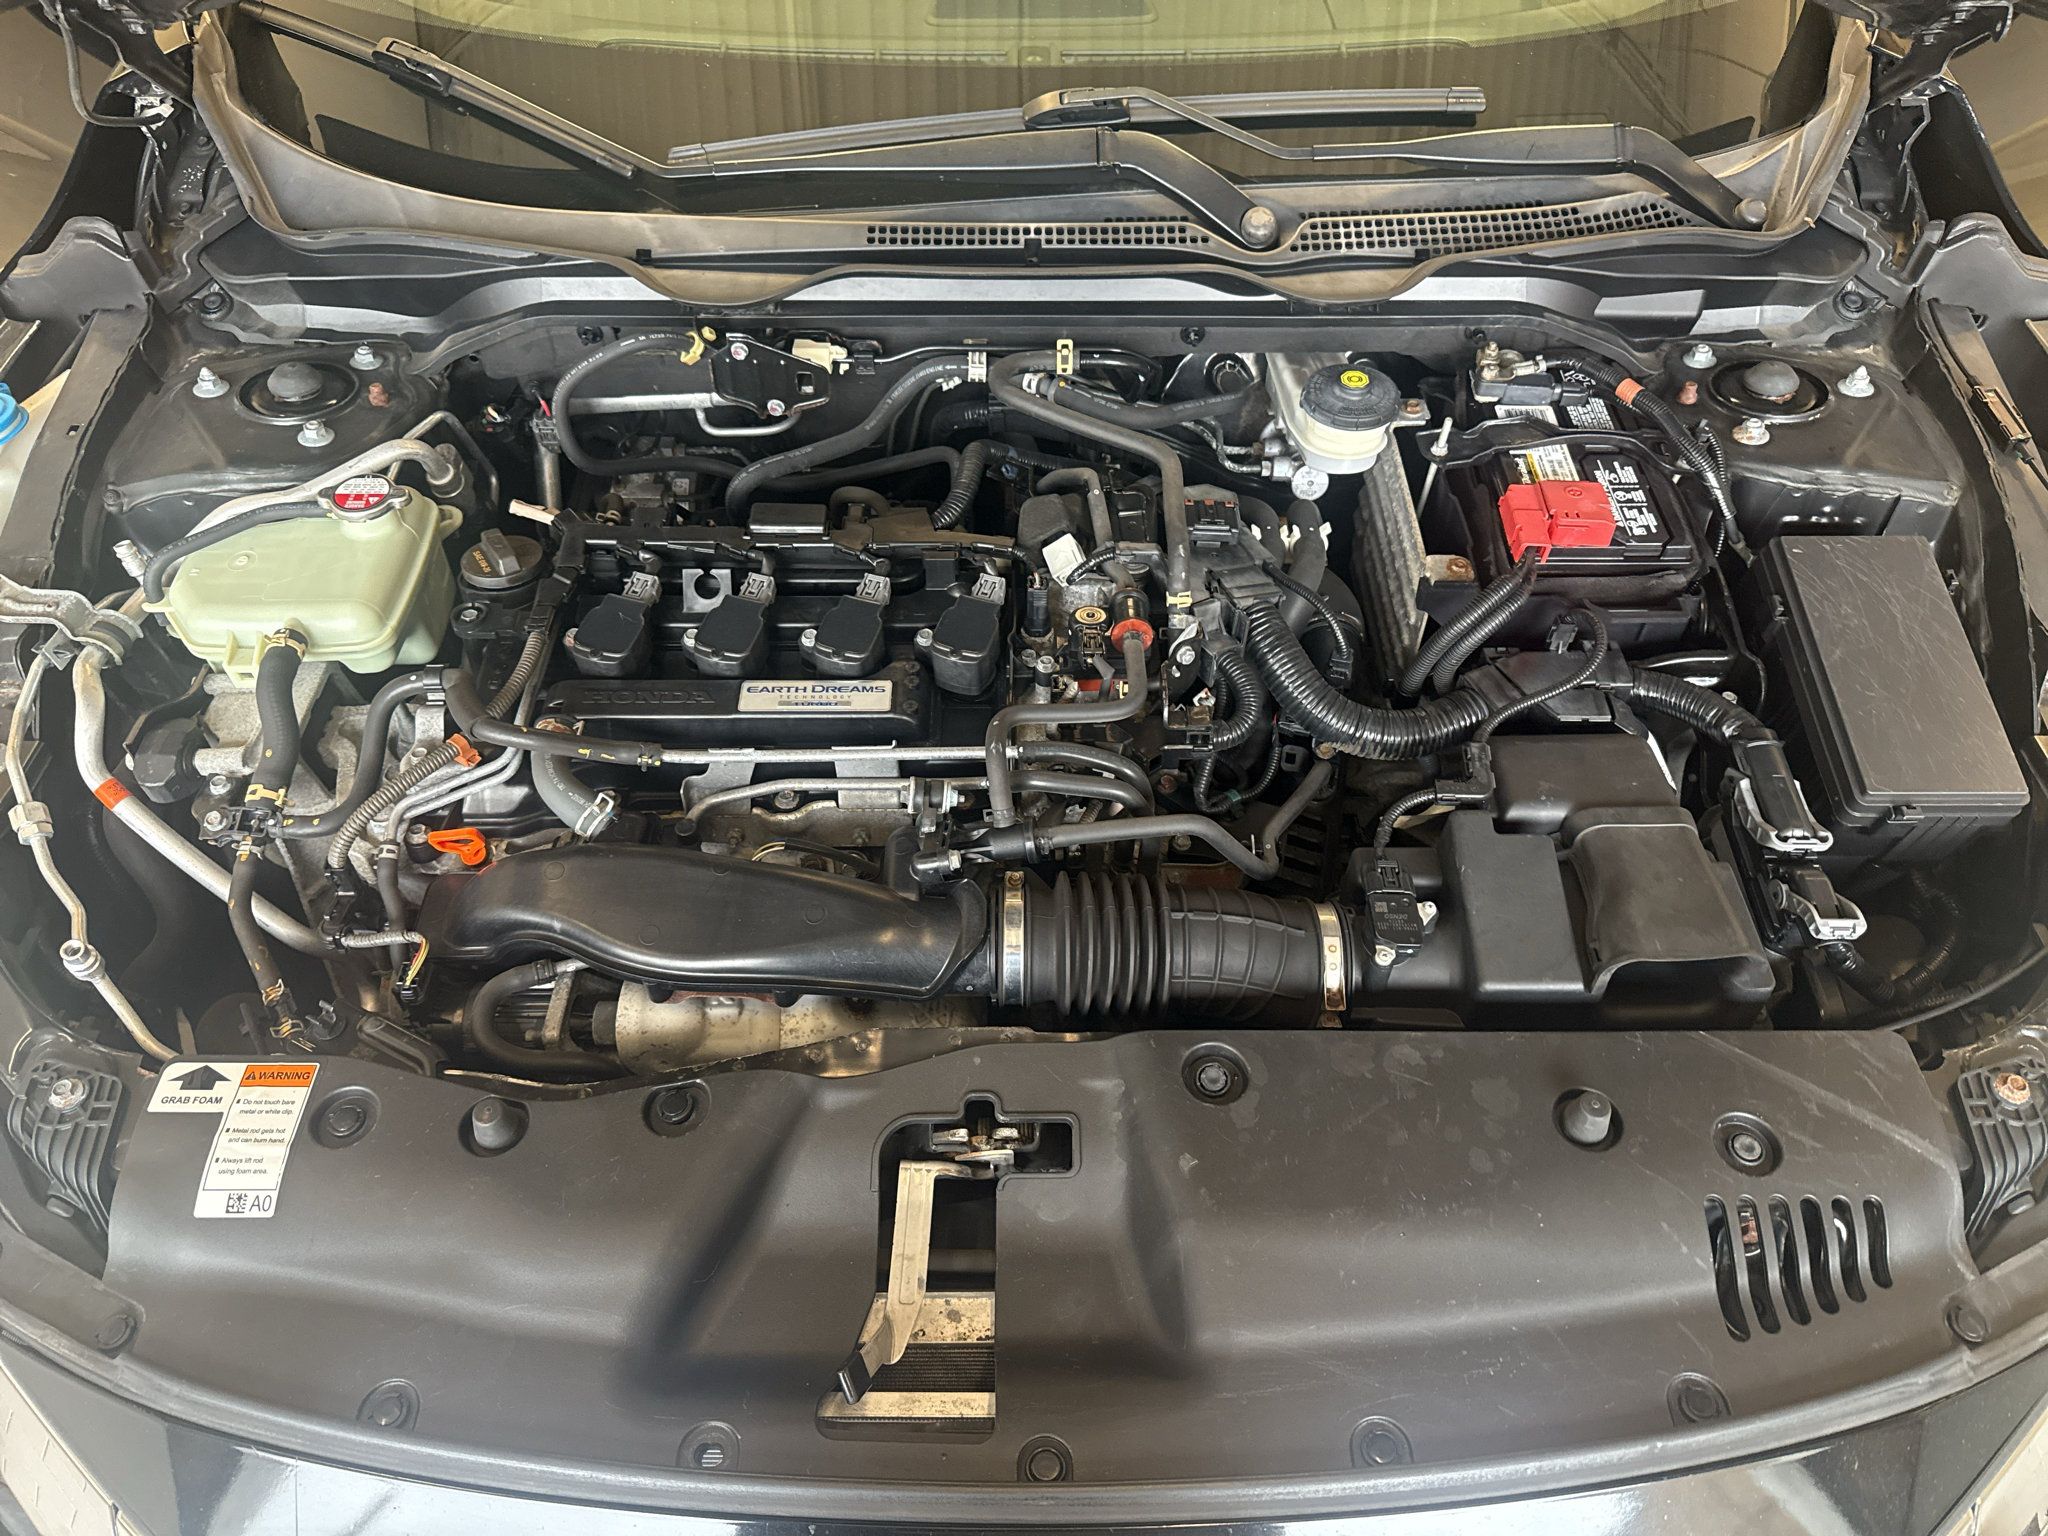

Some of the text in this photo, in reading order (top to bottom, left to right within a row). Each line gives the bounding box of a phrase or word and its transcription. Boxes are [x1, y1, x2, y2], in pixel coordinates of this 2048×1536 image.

[746, 686, 807, 694] EARTH
[580, 690, 716, 704] HONDA
[259, 1071, 311, 1080] WARNING
[160, 1096, 224, 1104] GRAB FOAM
[249, 1194, 272, 1212] A0
